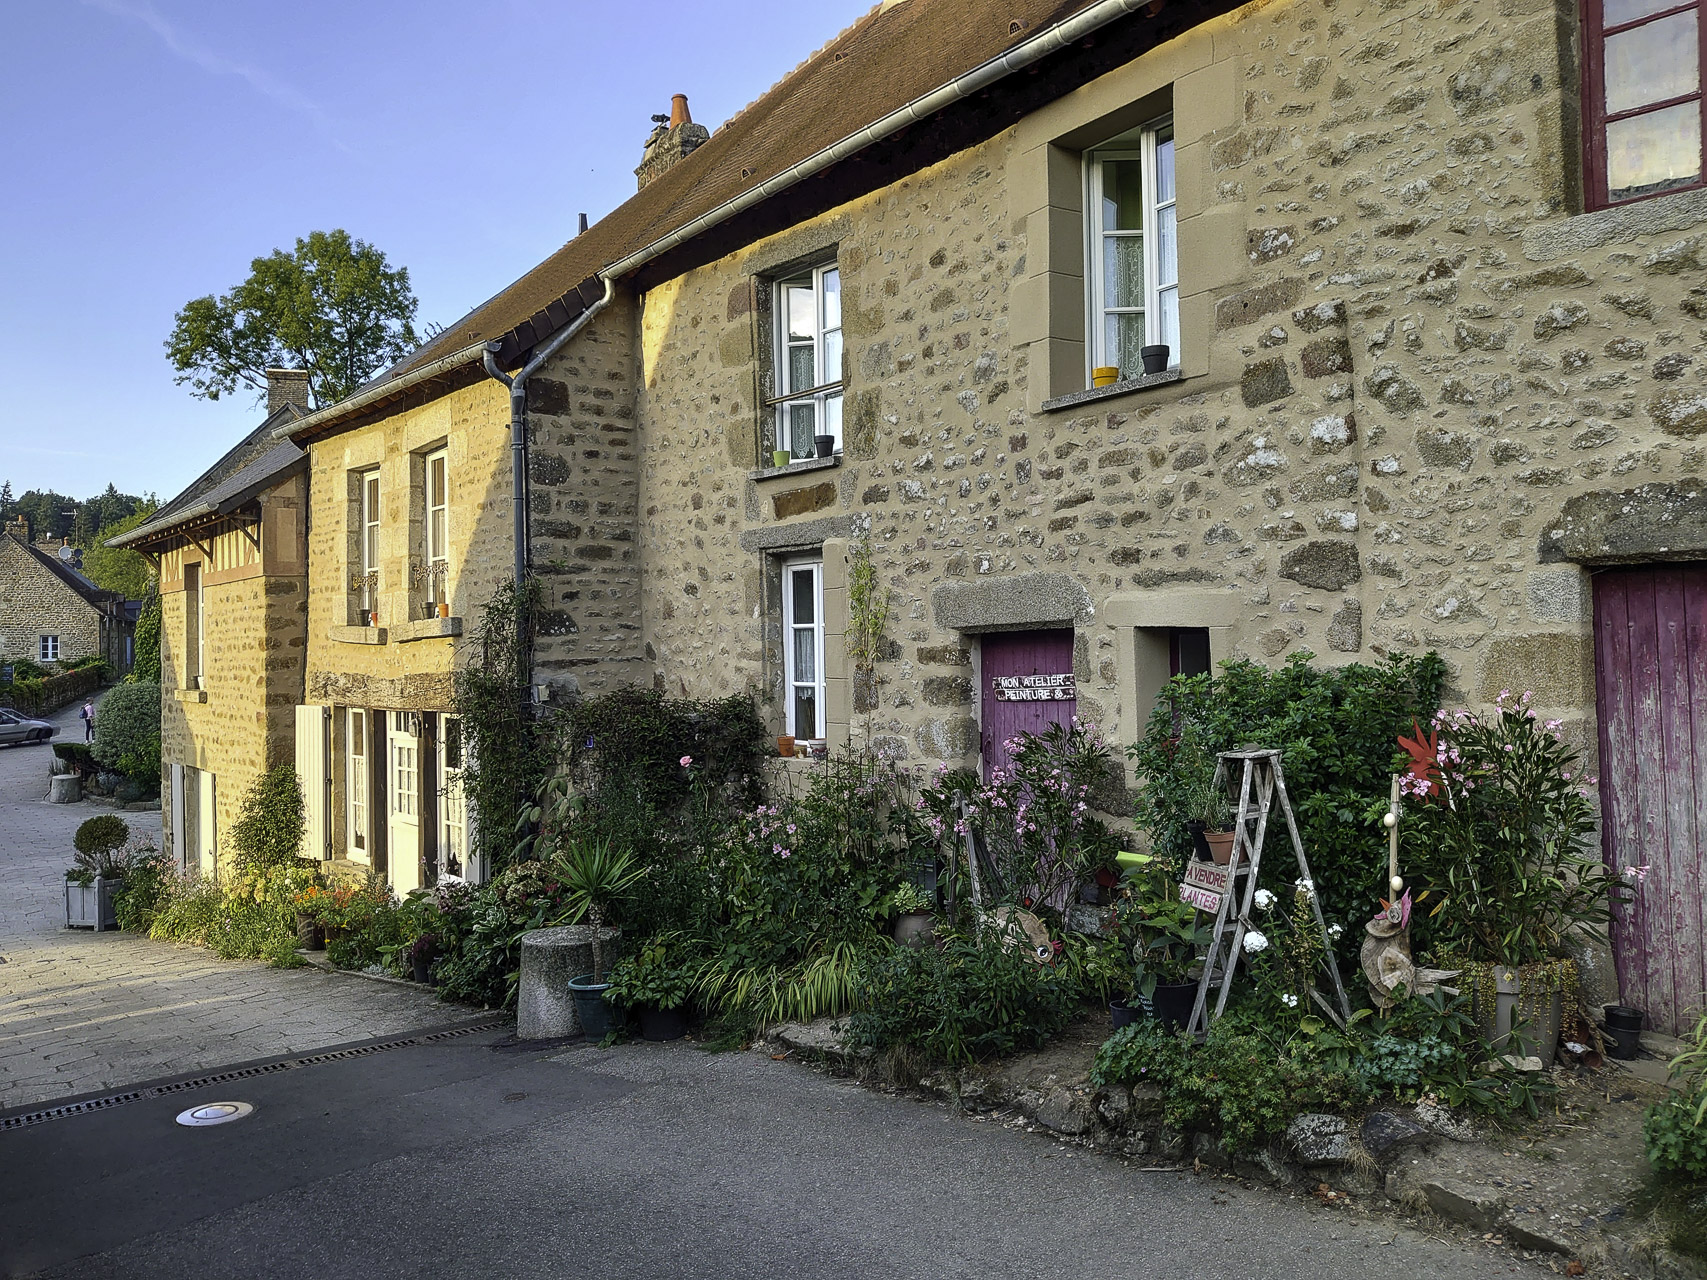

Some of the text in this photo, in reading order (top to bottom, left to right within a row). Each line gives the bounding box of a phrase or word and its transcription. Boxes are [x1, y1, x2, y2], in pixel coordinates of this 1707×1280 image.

[1001, 678, 1019, 688] MON
[1005, 689, 1051, 700] PEINTURE
[1194, 867, 1227, 889] VENDRE
